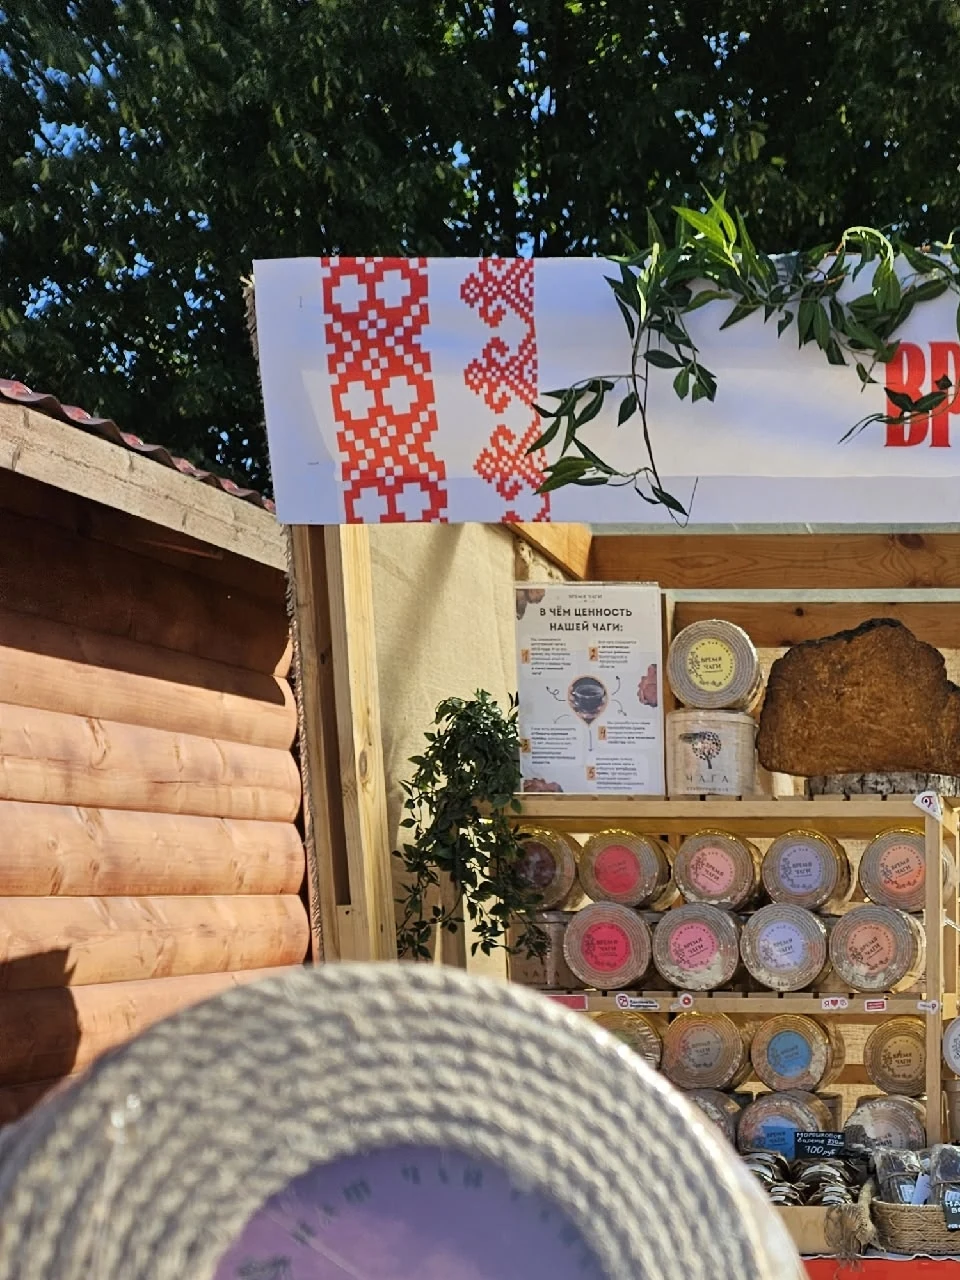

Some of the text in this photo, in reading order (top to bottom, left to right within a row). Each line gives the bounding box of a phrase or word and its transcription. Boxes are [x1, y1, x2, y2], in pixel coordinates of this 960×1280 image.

[540, 605, 633, 618] В ЧЁМ ЦЕННОСТЬ
[549, 621, 624, 632] НАШЕЙ ЧАГИ:
[686, 775, 729, 784] ЧАГА
